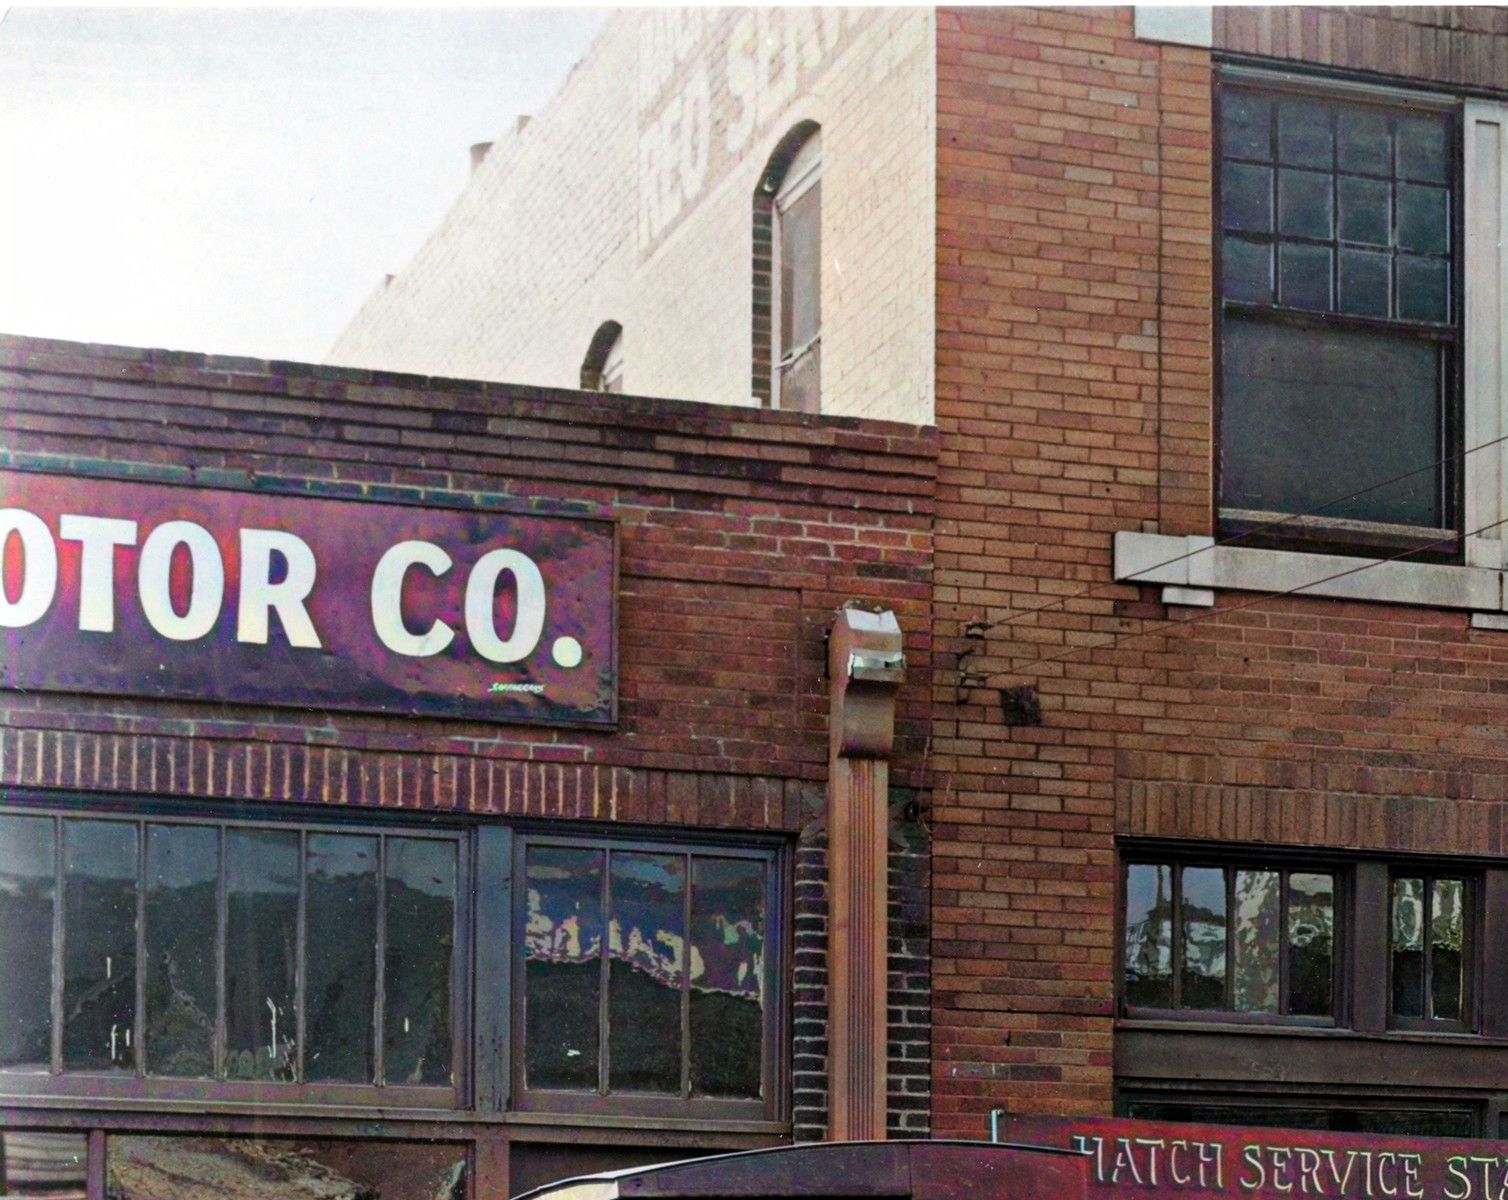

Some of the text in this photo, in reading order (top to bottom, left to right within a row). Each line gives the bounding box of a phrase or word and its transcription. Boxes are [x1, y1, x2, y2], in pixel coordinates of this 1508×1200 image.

[0, 507, 583, 668] OTOR CO.
[1073, 1135, 1224, 1188] HATCH
[1239, 1144, 1424, 1199] SERVICE
